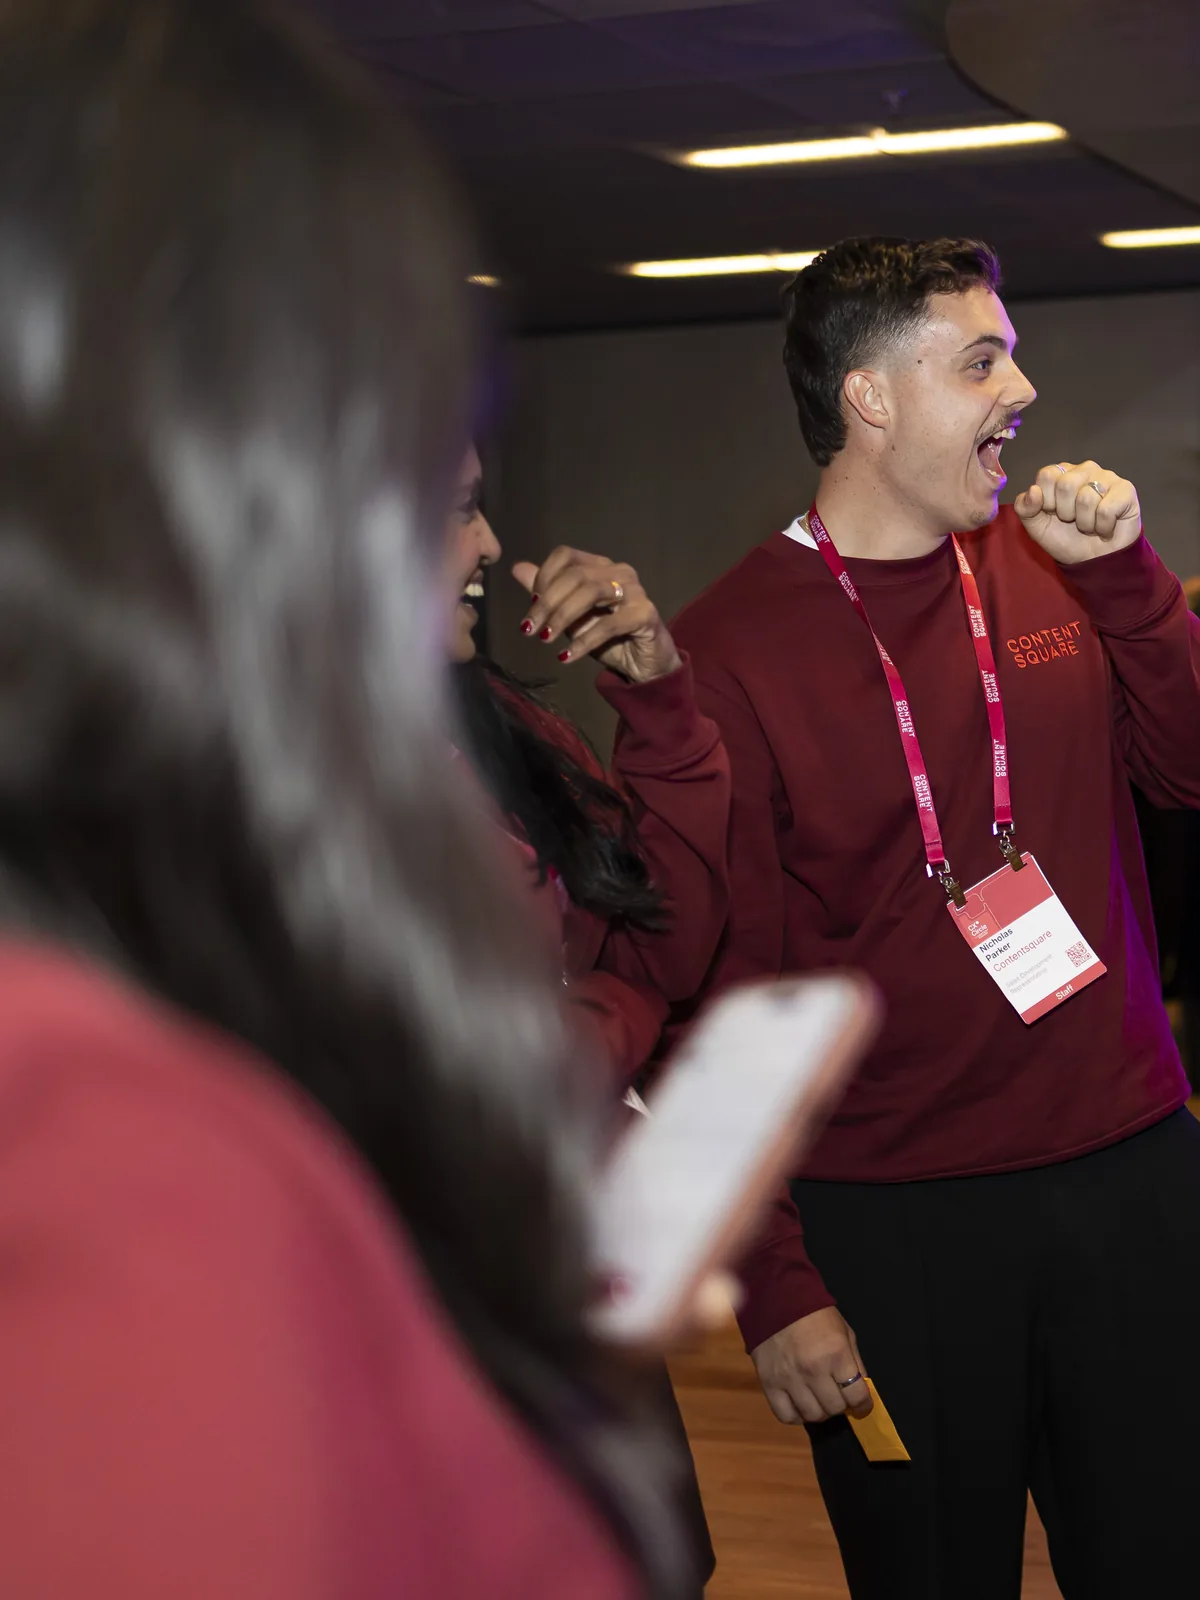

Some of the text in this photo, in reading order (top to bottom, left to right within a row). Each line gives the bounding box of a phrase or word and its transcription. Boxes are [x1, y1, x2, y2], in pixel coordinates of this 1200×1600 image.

[841, 571, 860, 602] CONTENT
[967, 604, 981, 638] CONTENT
[976, 609, 987, 638] SQUARE
[1006, 621, 1081, 654] CONTENT
[1013, 640, 1079, 669] SQUARE
[981, 669, 994, 703] CONTENT
[988, 673, 1000, 703] SQUARE
[895, 701, 908, 733] SQUARE
[901, 700, 916, 737] CONTENT
[993, 739, 1001, 777] CONTENT
[999, 745, 1007, 777] SQUARE
[913, 775, 926, 808] SQUARE
[919, 774, 933, 812] CONTENT
[979, 928, 1014, 954] Nicholas
[985, 942, 1011, 962] Parker
[993, 930, 1053, 972] Contentsquare
[1055, 984, 1074, 1000] Staff
